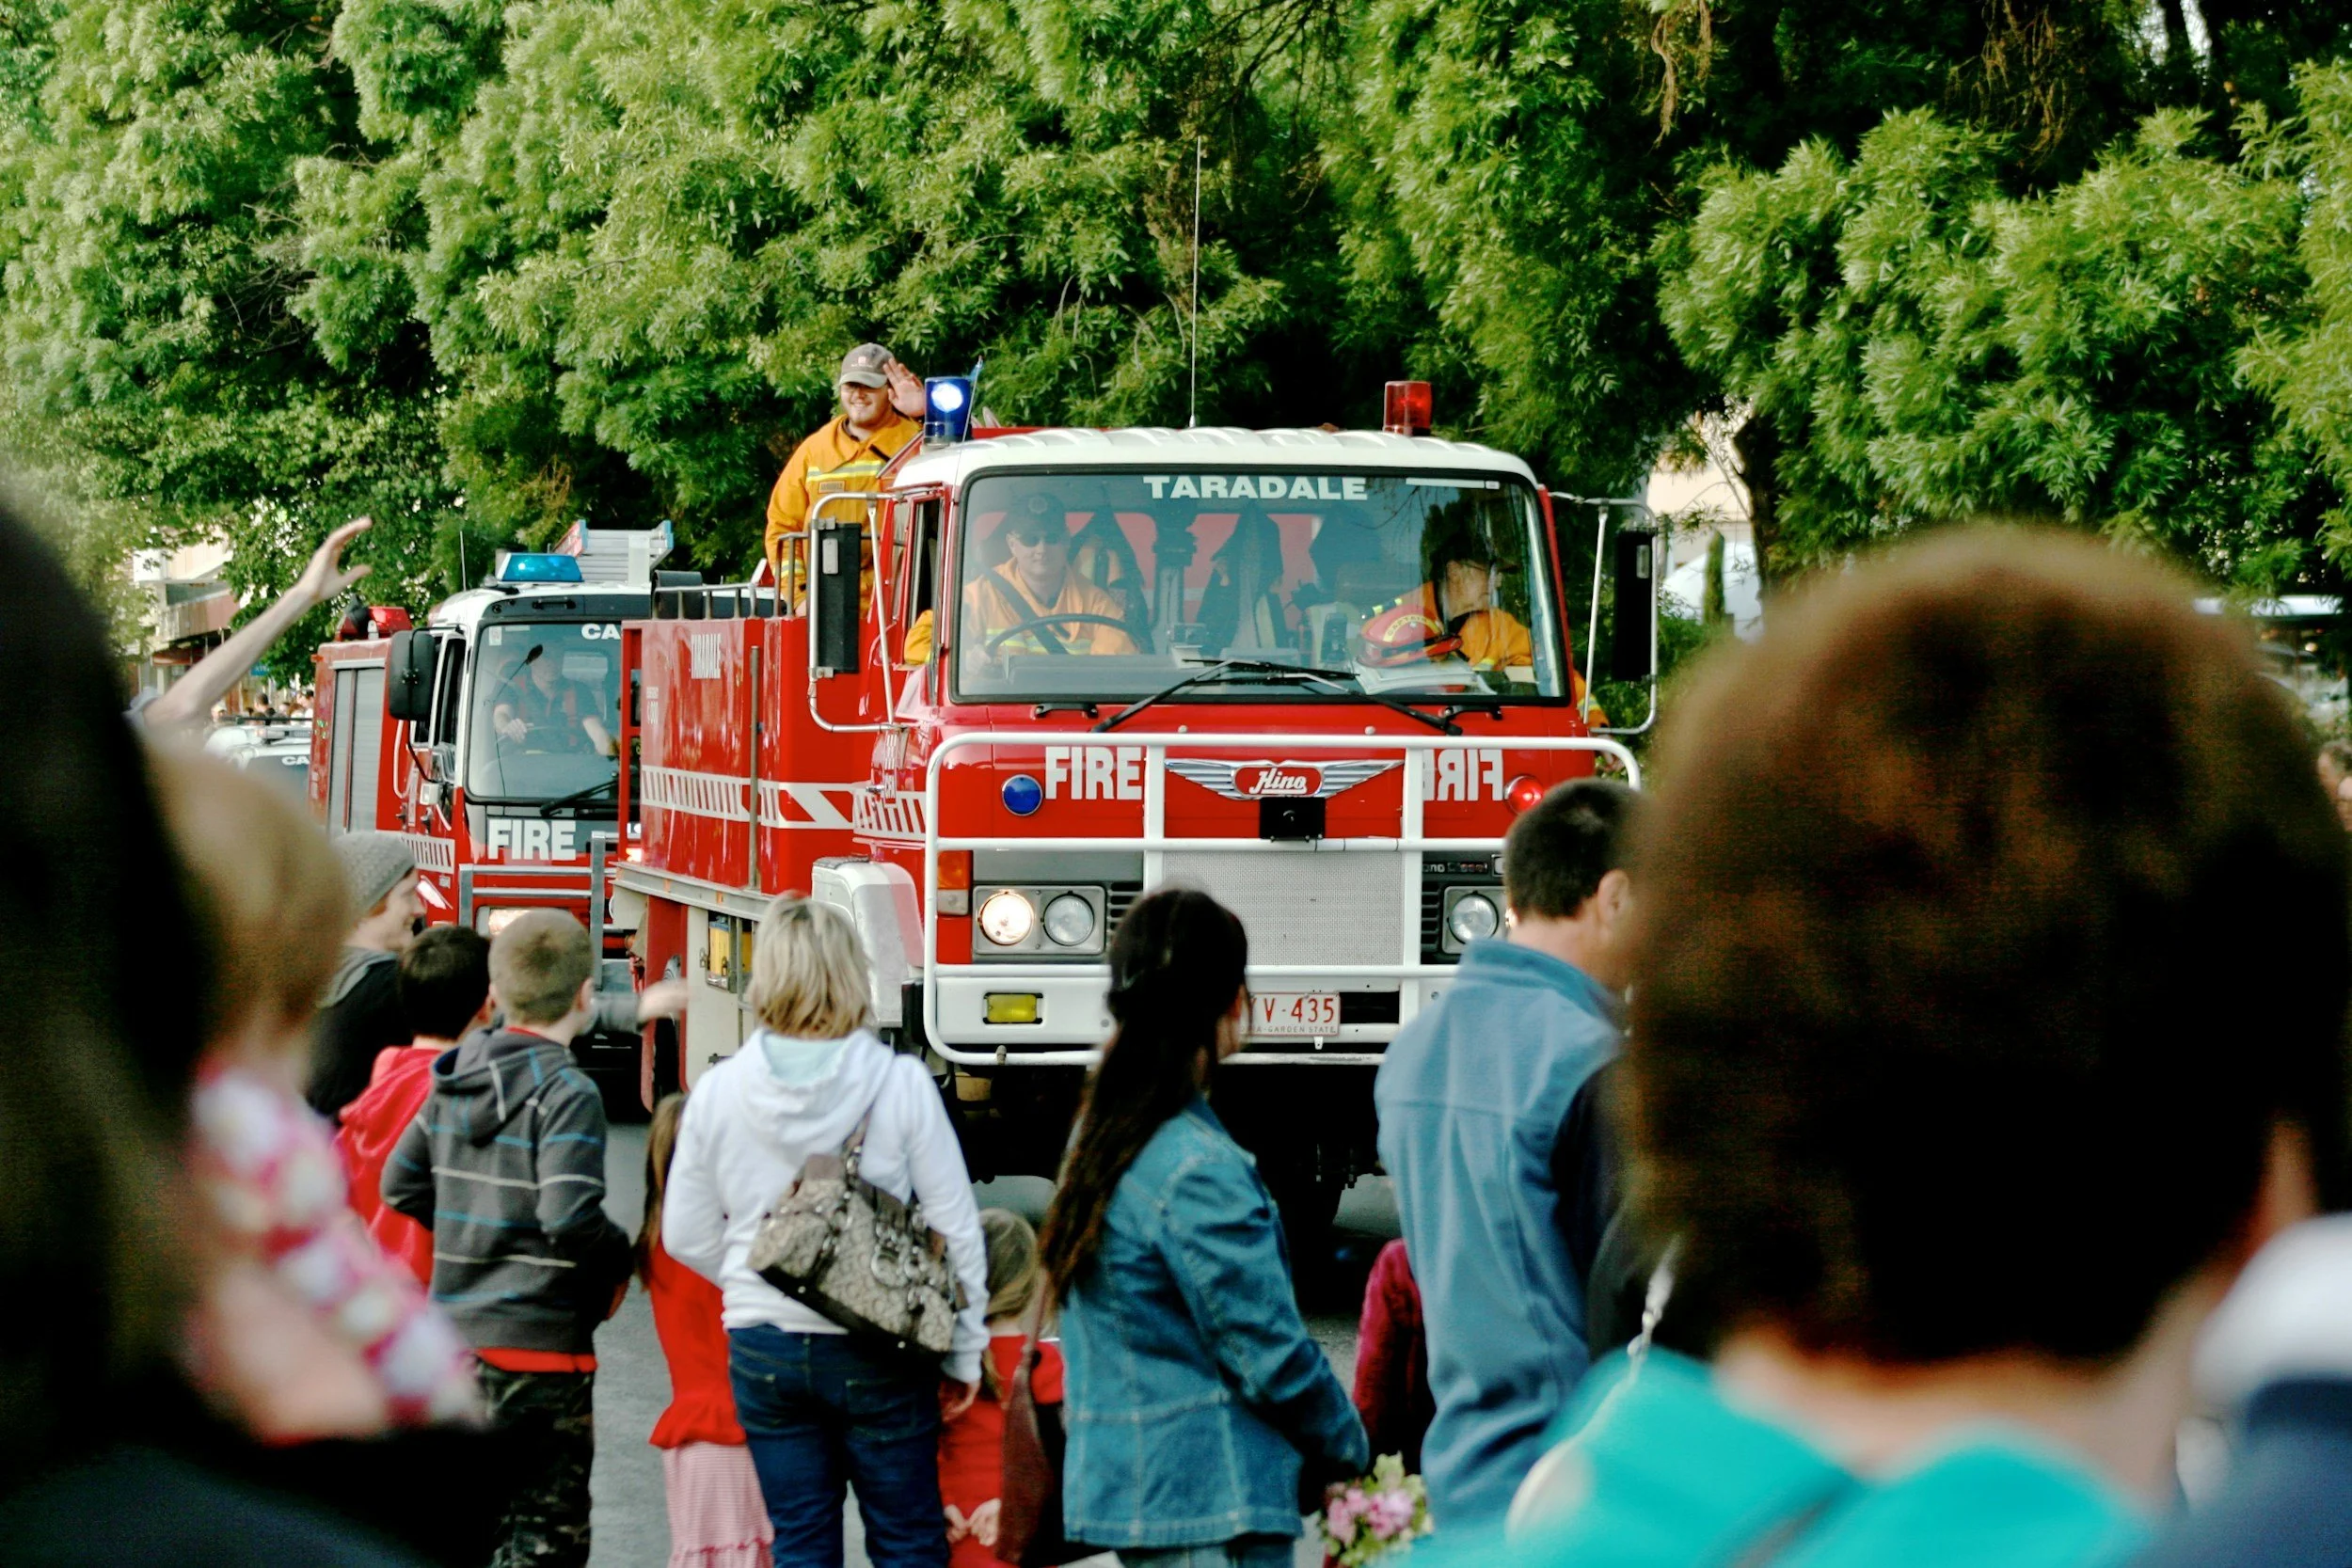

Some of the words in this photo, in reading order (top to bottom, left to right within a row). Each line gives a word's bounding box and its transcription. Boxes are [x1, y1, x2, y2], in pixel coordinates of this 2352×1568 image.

[1143, 476, 1368, 500] TARADALE
[1045, 746, 1142, 800] FIRE
[1248, 768, 1308, 795] Hino
[488, 819, 576, 861] FIRE
